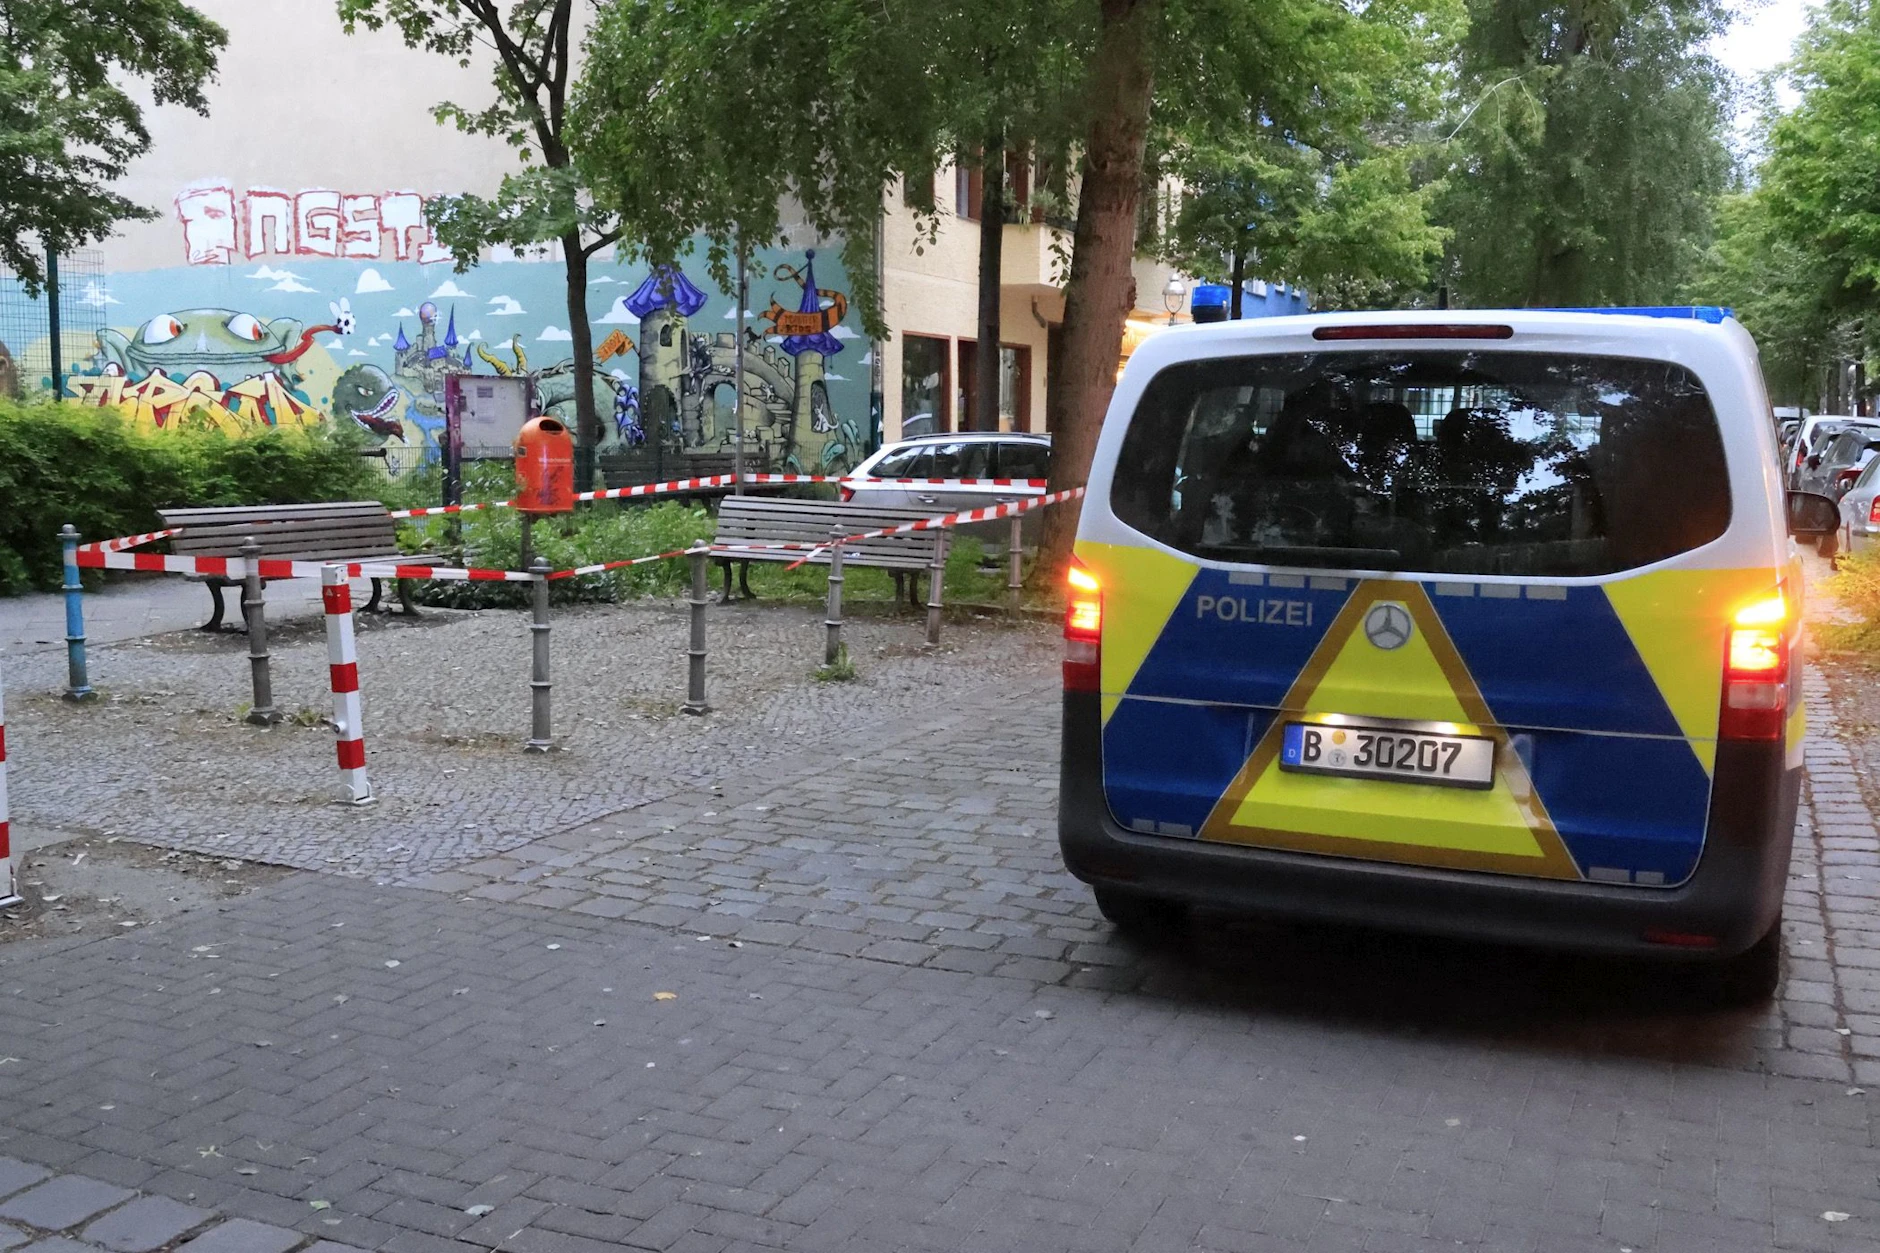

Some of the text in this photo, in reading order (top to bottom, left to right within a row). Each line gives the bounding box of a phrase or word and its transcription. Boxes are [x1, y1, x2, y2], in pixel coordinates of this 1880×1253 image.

[1196, 595, 1313, 626] POLIZEI
[1288, 749, 1296, 758] D
[1304, 730, 1322, 762] B
[1353, 734, 1462, 774] 30207
